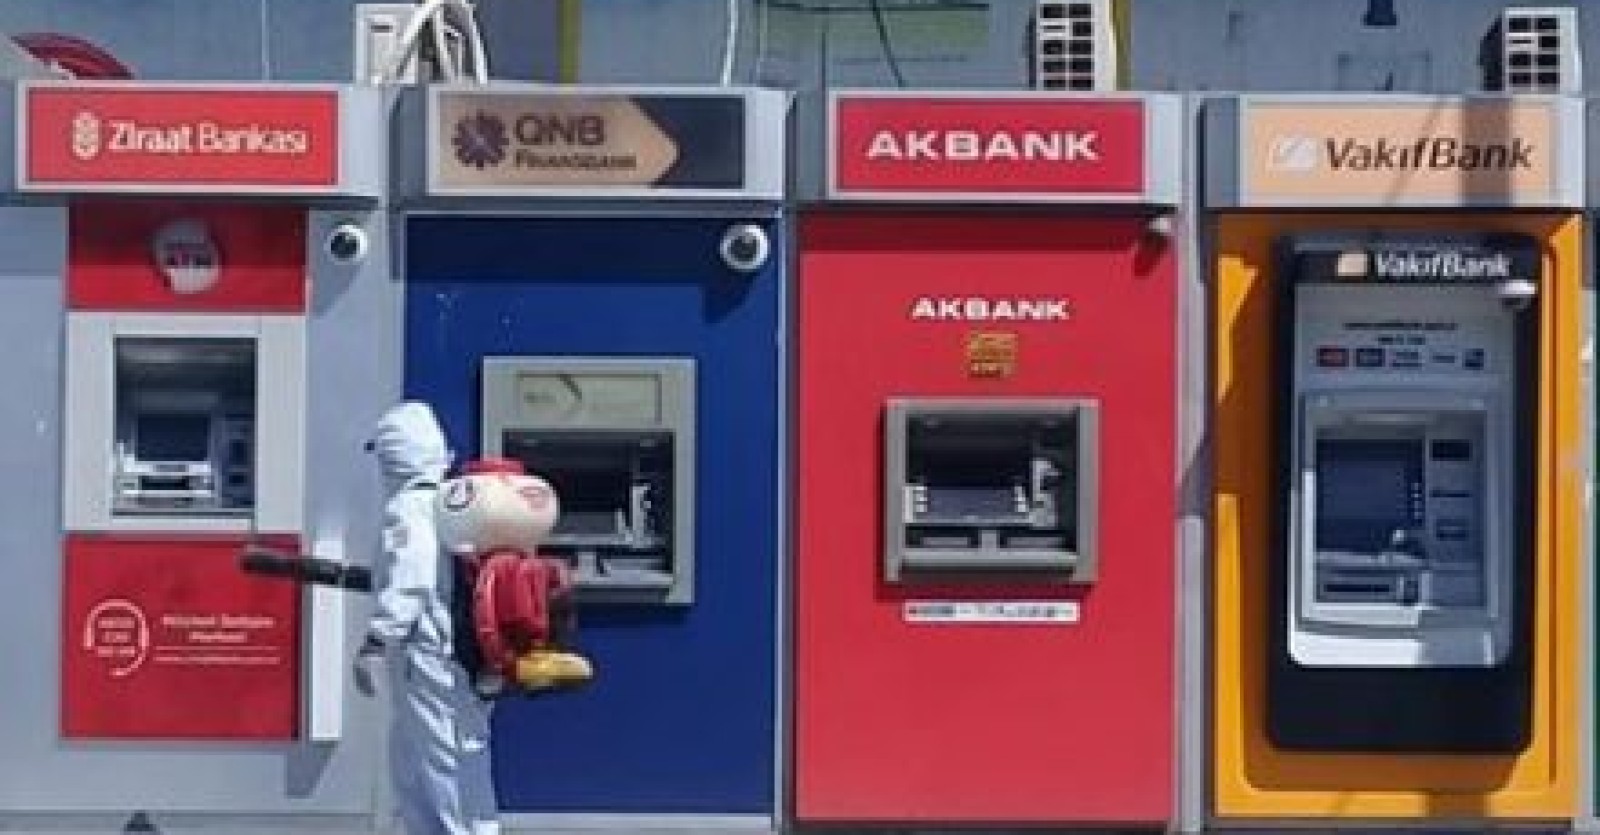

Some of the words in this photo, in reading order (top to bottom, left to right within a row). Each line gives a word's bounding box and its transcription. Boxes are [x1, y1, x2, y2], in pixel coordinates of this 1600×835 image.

[107, 119, 193, 153] Ziraat
[199, 119, 307, 155] Bankası
[515, 112, 606, 147] QNB
[866, 130, 1099, 161] AKBANK
[1326, 137, 1533, 171] VakıfBank
[1377, 251, 1511, 278] VakıfBank
[912, 297, 1070, 321] AKBANK
